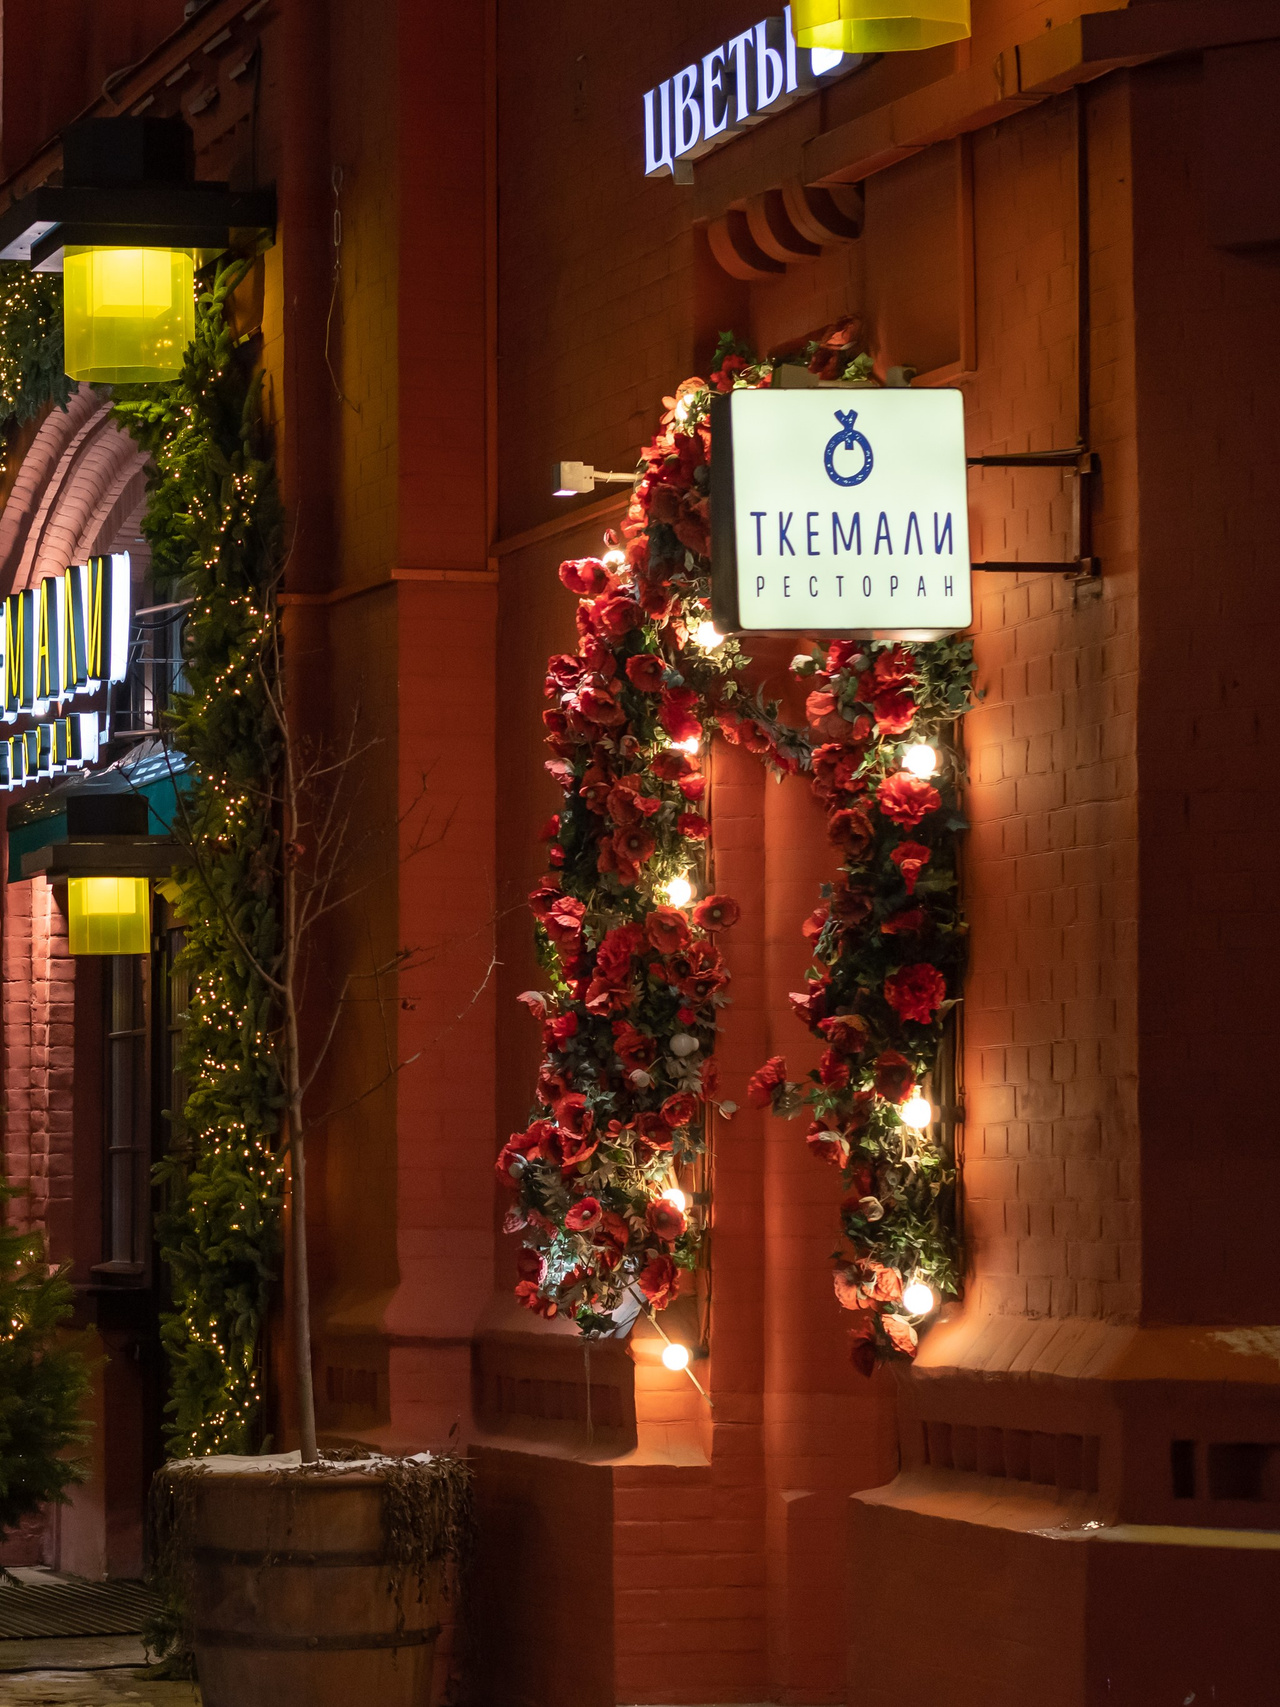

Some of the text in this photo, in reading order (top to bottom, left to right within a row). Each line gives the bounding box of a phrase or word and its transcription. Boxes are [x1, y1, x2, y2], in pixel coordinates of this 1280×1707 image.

[643, 5, 798, 175] ЦВЕТЫ
[750, 511, 953, 556] ТКЕМАЛИ
[756, 575, 953, 597] РЕСТОРАН
